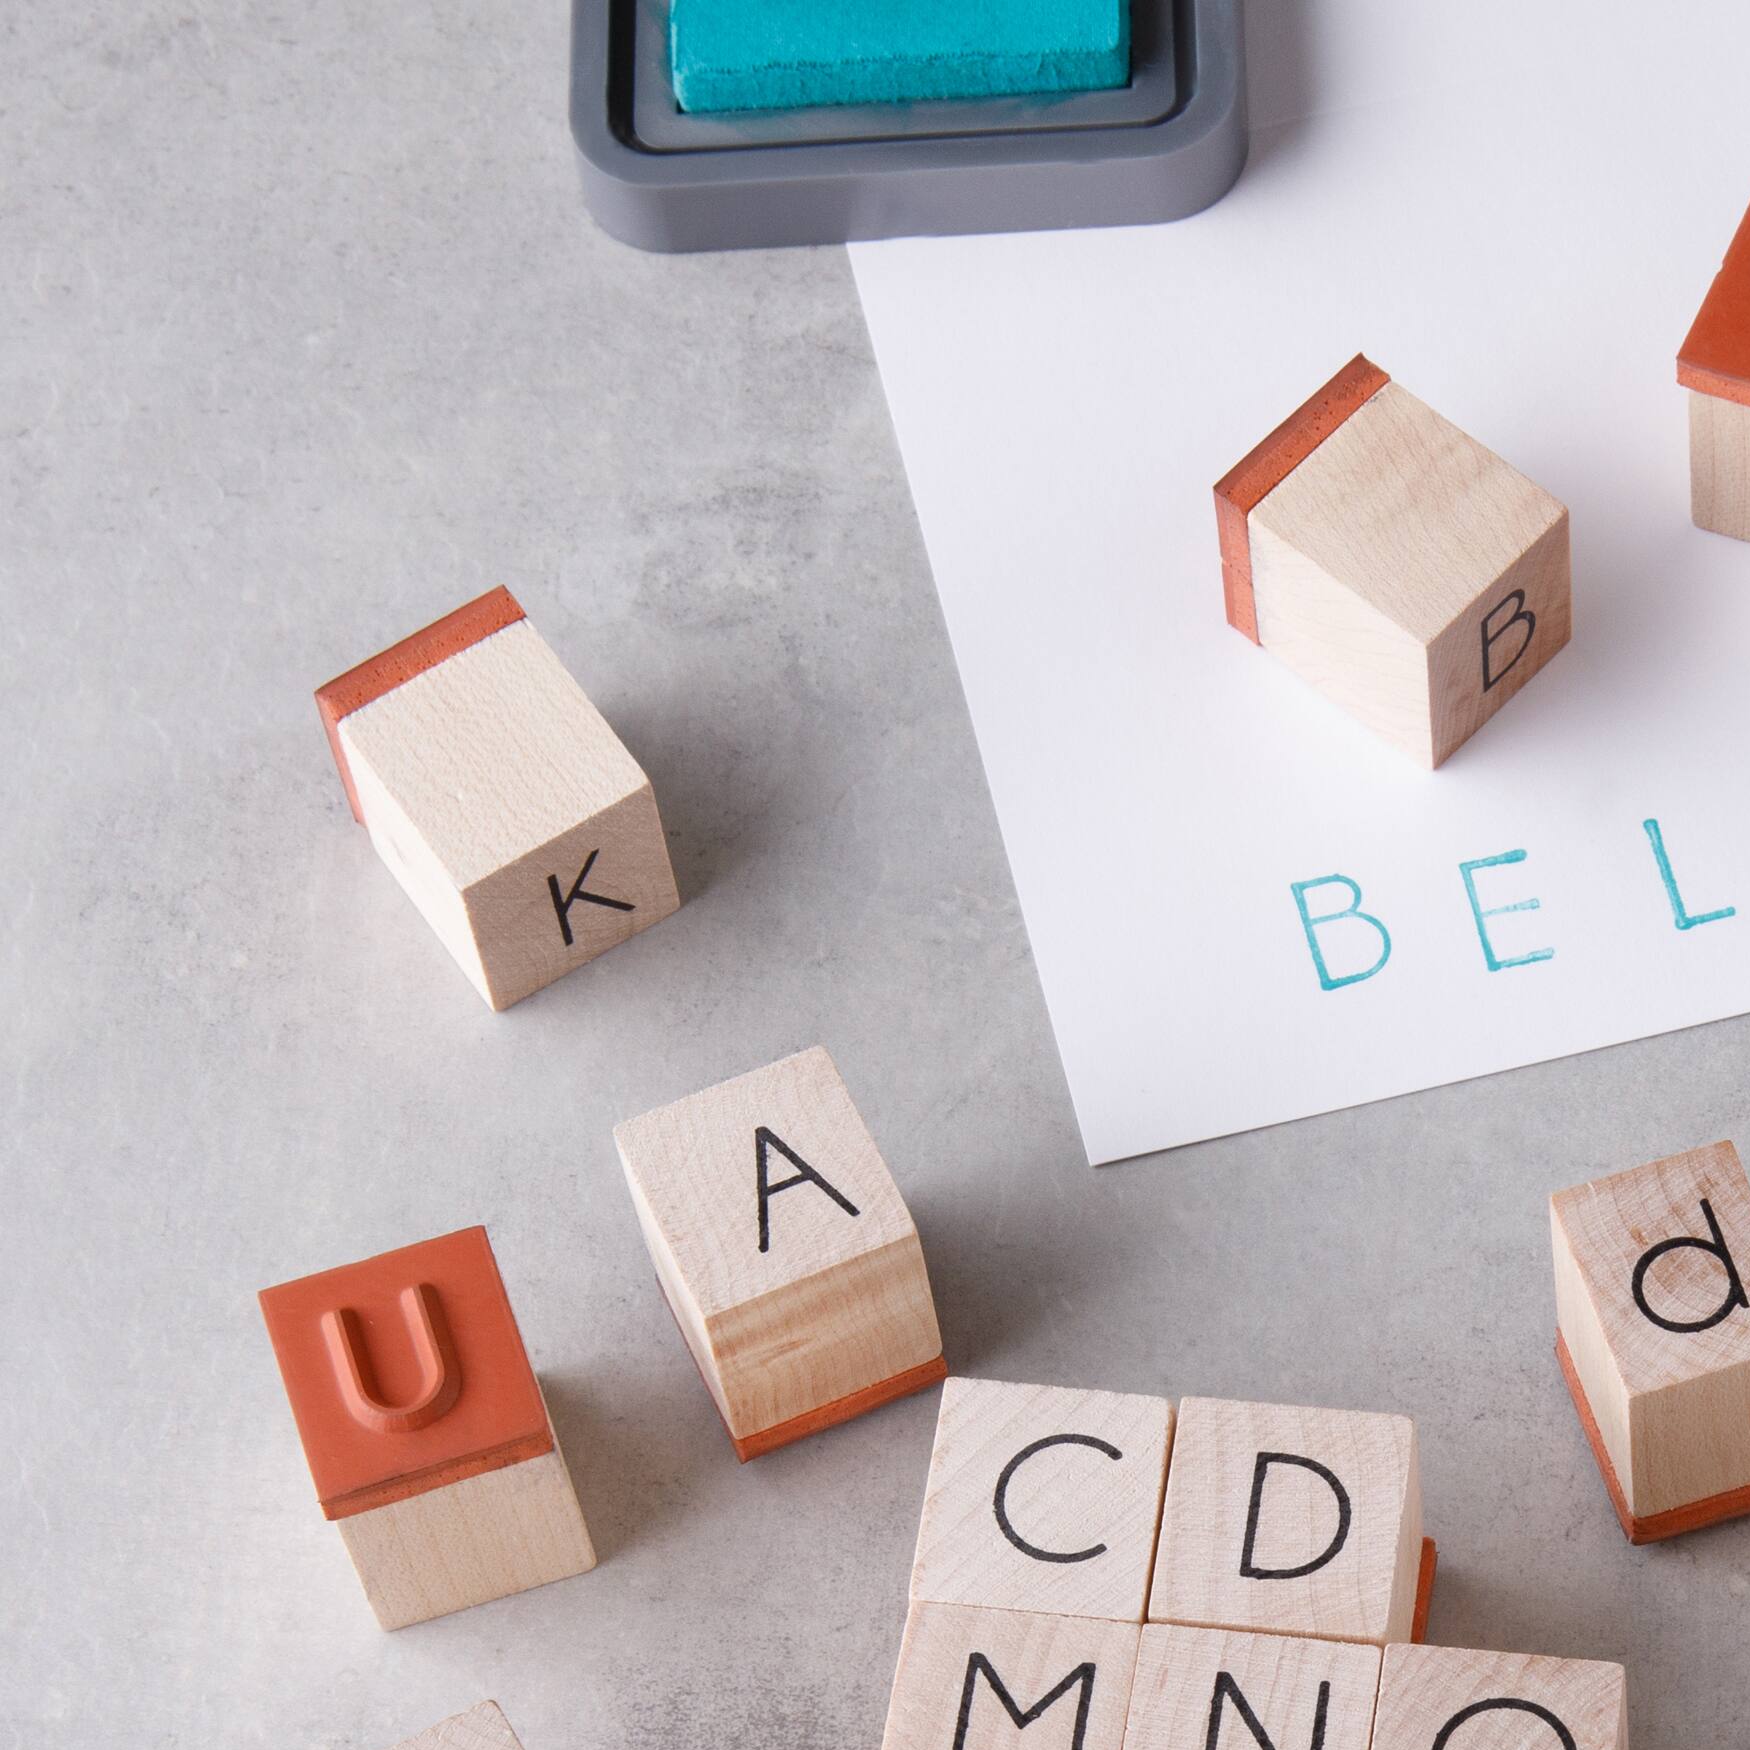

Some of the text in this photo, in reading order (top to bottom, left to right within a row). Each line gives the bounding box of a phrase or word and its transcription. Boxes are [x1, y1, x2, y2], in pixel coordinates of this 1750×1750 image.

[1480, 588, 1537, 693] B
[547, 848, 636, 947] K
[755, 1126, 860, 1253] A
[1631, 1198, 1750, 1334] d
[320, 1281, 463, 1434] U
[993, 1433, 1352, 1580] C D
